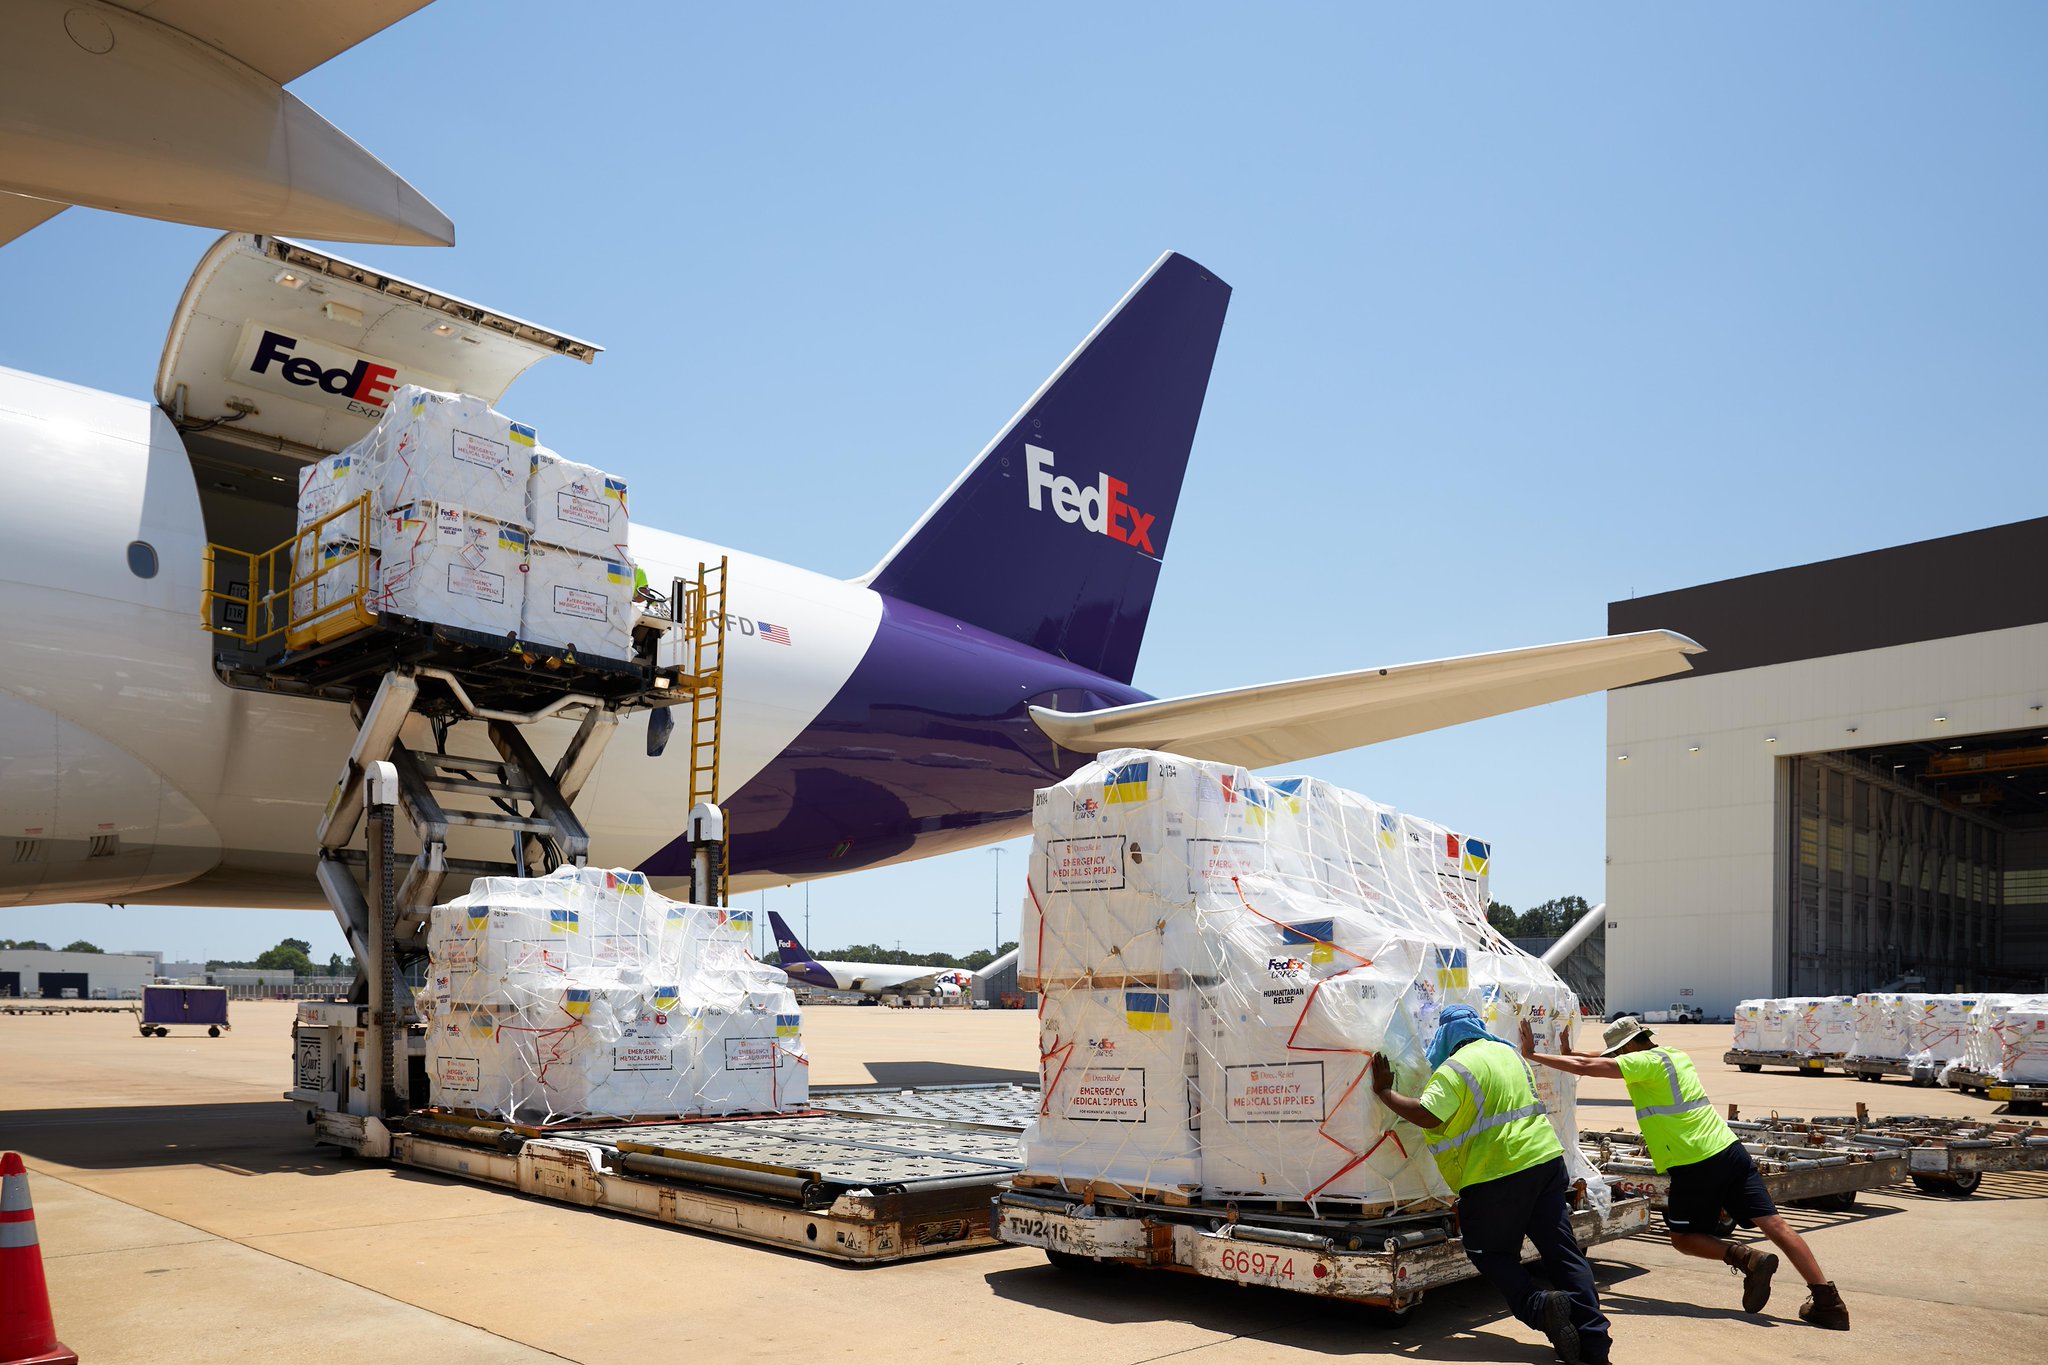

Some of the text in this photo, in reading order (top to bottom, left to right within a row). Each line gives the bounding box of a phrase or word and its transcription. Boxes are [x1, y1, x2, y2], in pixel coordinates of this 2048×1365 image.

[346, 401, 385, 420] Exp
[1025, 443, 1156, 555] FedEx
[440, 508, 460, 518] FedEx
[1072, 798, 1099, 812] FedEx
[1268, 958, 1305, 970] FedEx
[937, 972, 971, 987] edEx
[1263, 987, 1305, 998] HUMANITARIAN
[1273, 995, 1295, 1005] RELIEF
[1529, 1005, 1547, 1017] FedEx
[1080, 1087, 1126, 1096] EMERGENCY
[1246, 1084, 1301, 1096] EMERGENCY
[1009, 1216, 1069, 1241] TW2410
[1222, 1248, 1295, 1281] 66974
